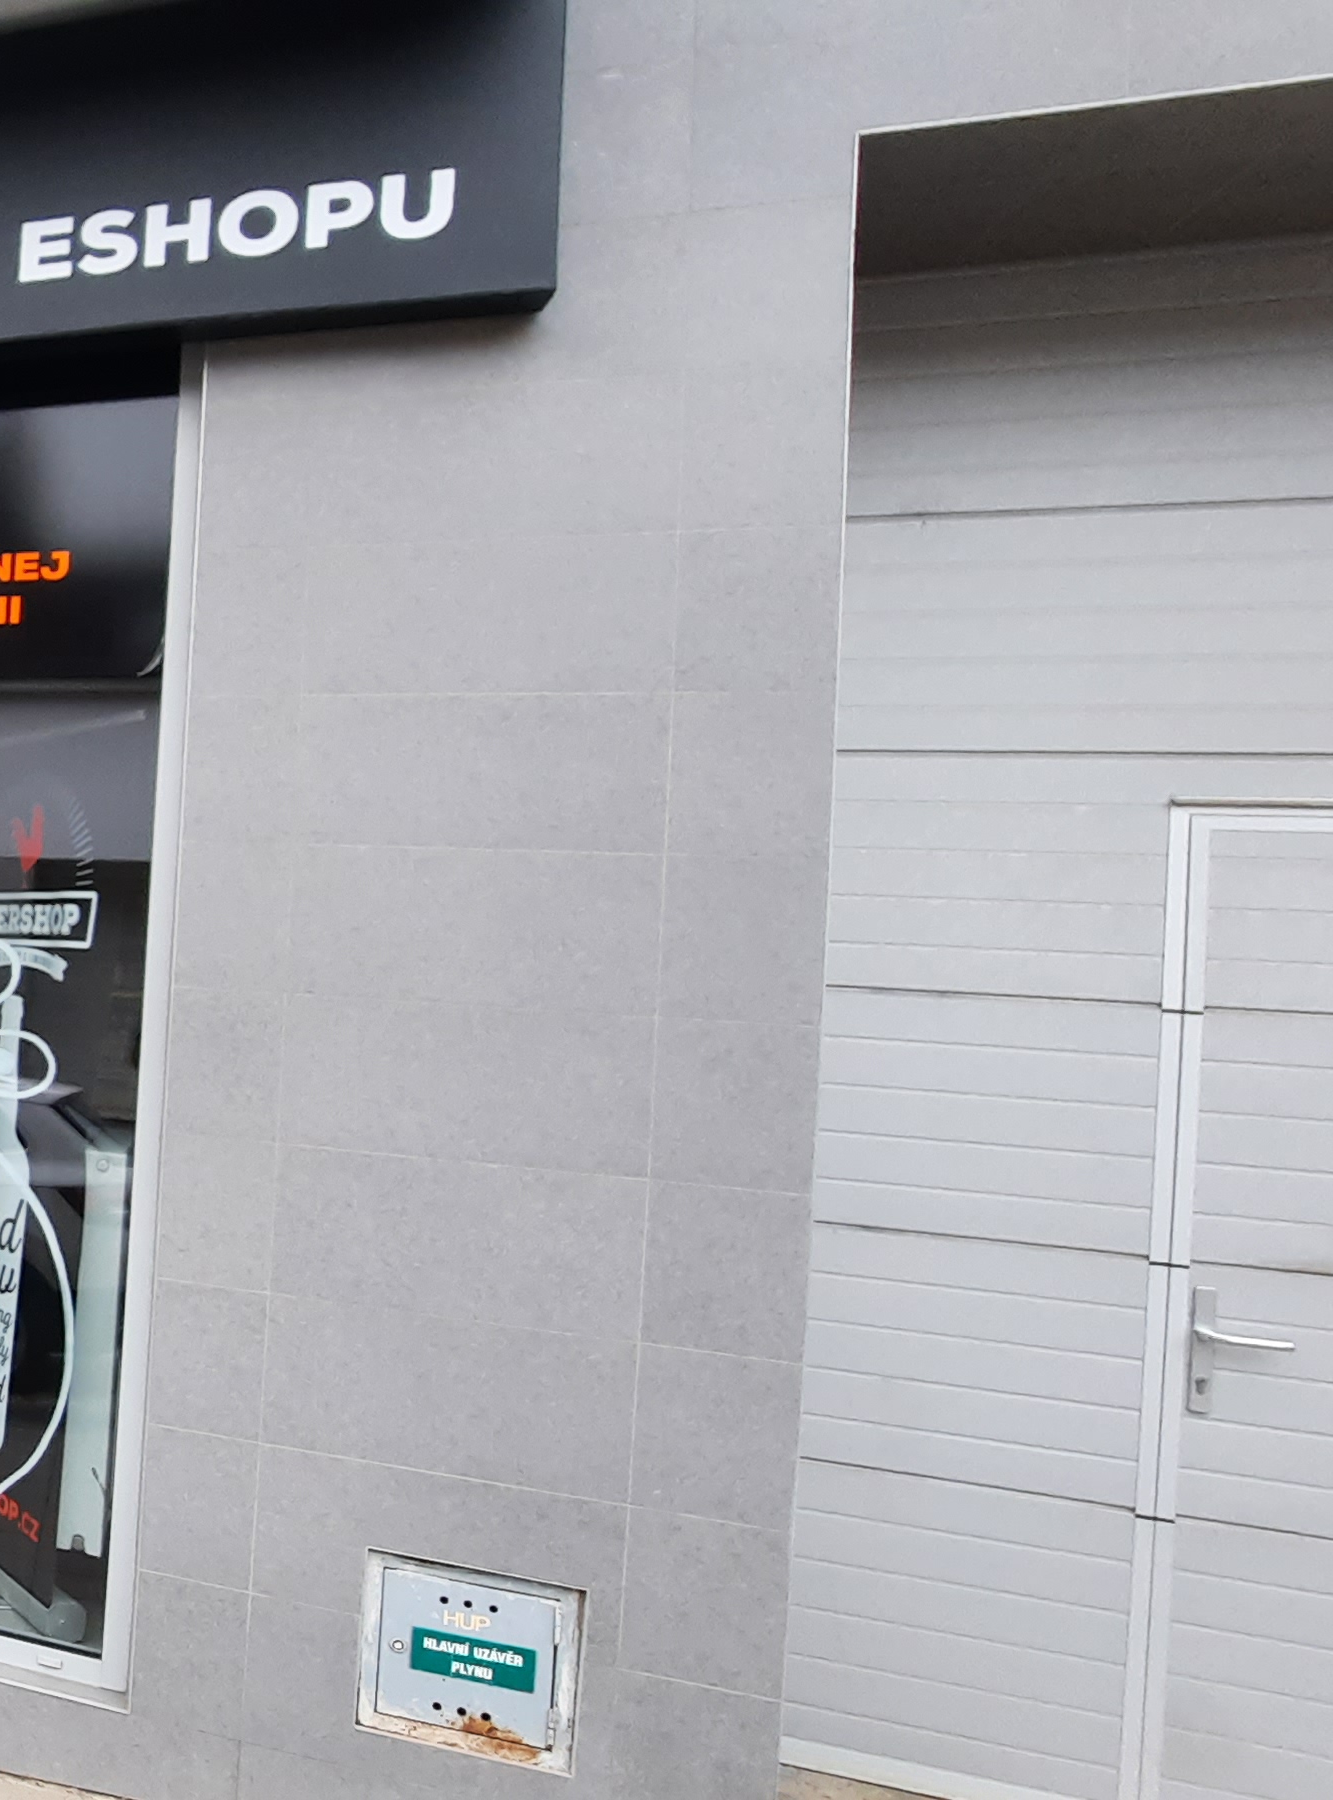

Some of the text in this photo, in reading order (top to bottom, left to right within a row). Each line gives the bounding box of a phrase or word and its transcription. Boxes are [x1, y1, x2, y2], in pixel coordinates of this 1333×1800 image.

[17, 167, 457, 284] ESHOPU
[442, 1609, 492, 1632] HUP
[422, 1636, 525, 1668] HLAVNÍ UZÁVĚR
[450, 1660, 494, 1681] PLYNU
